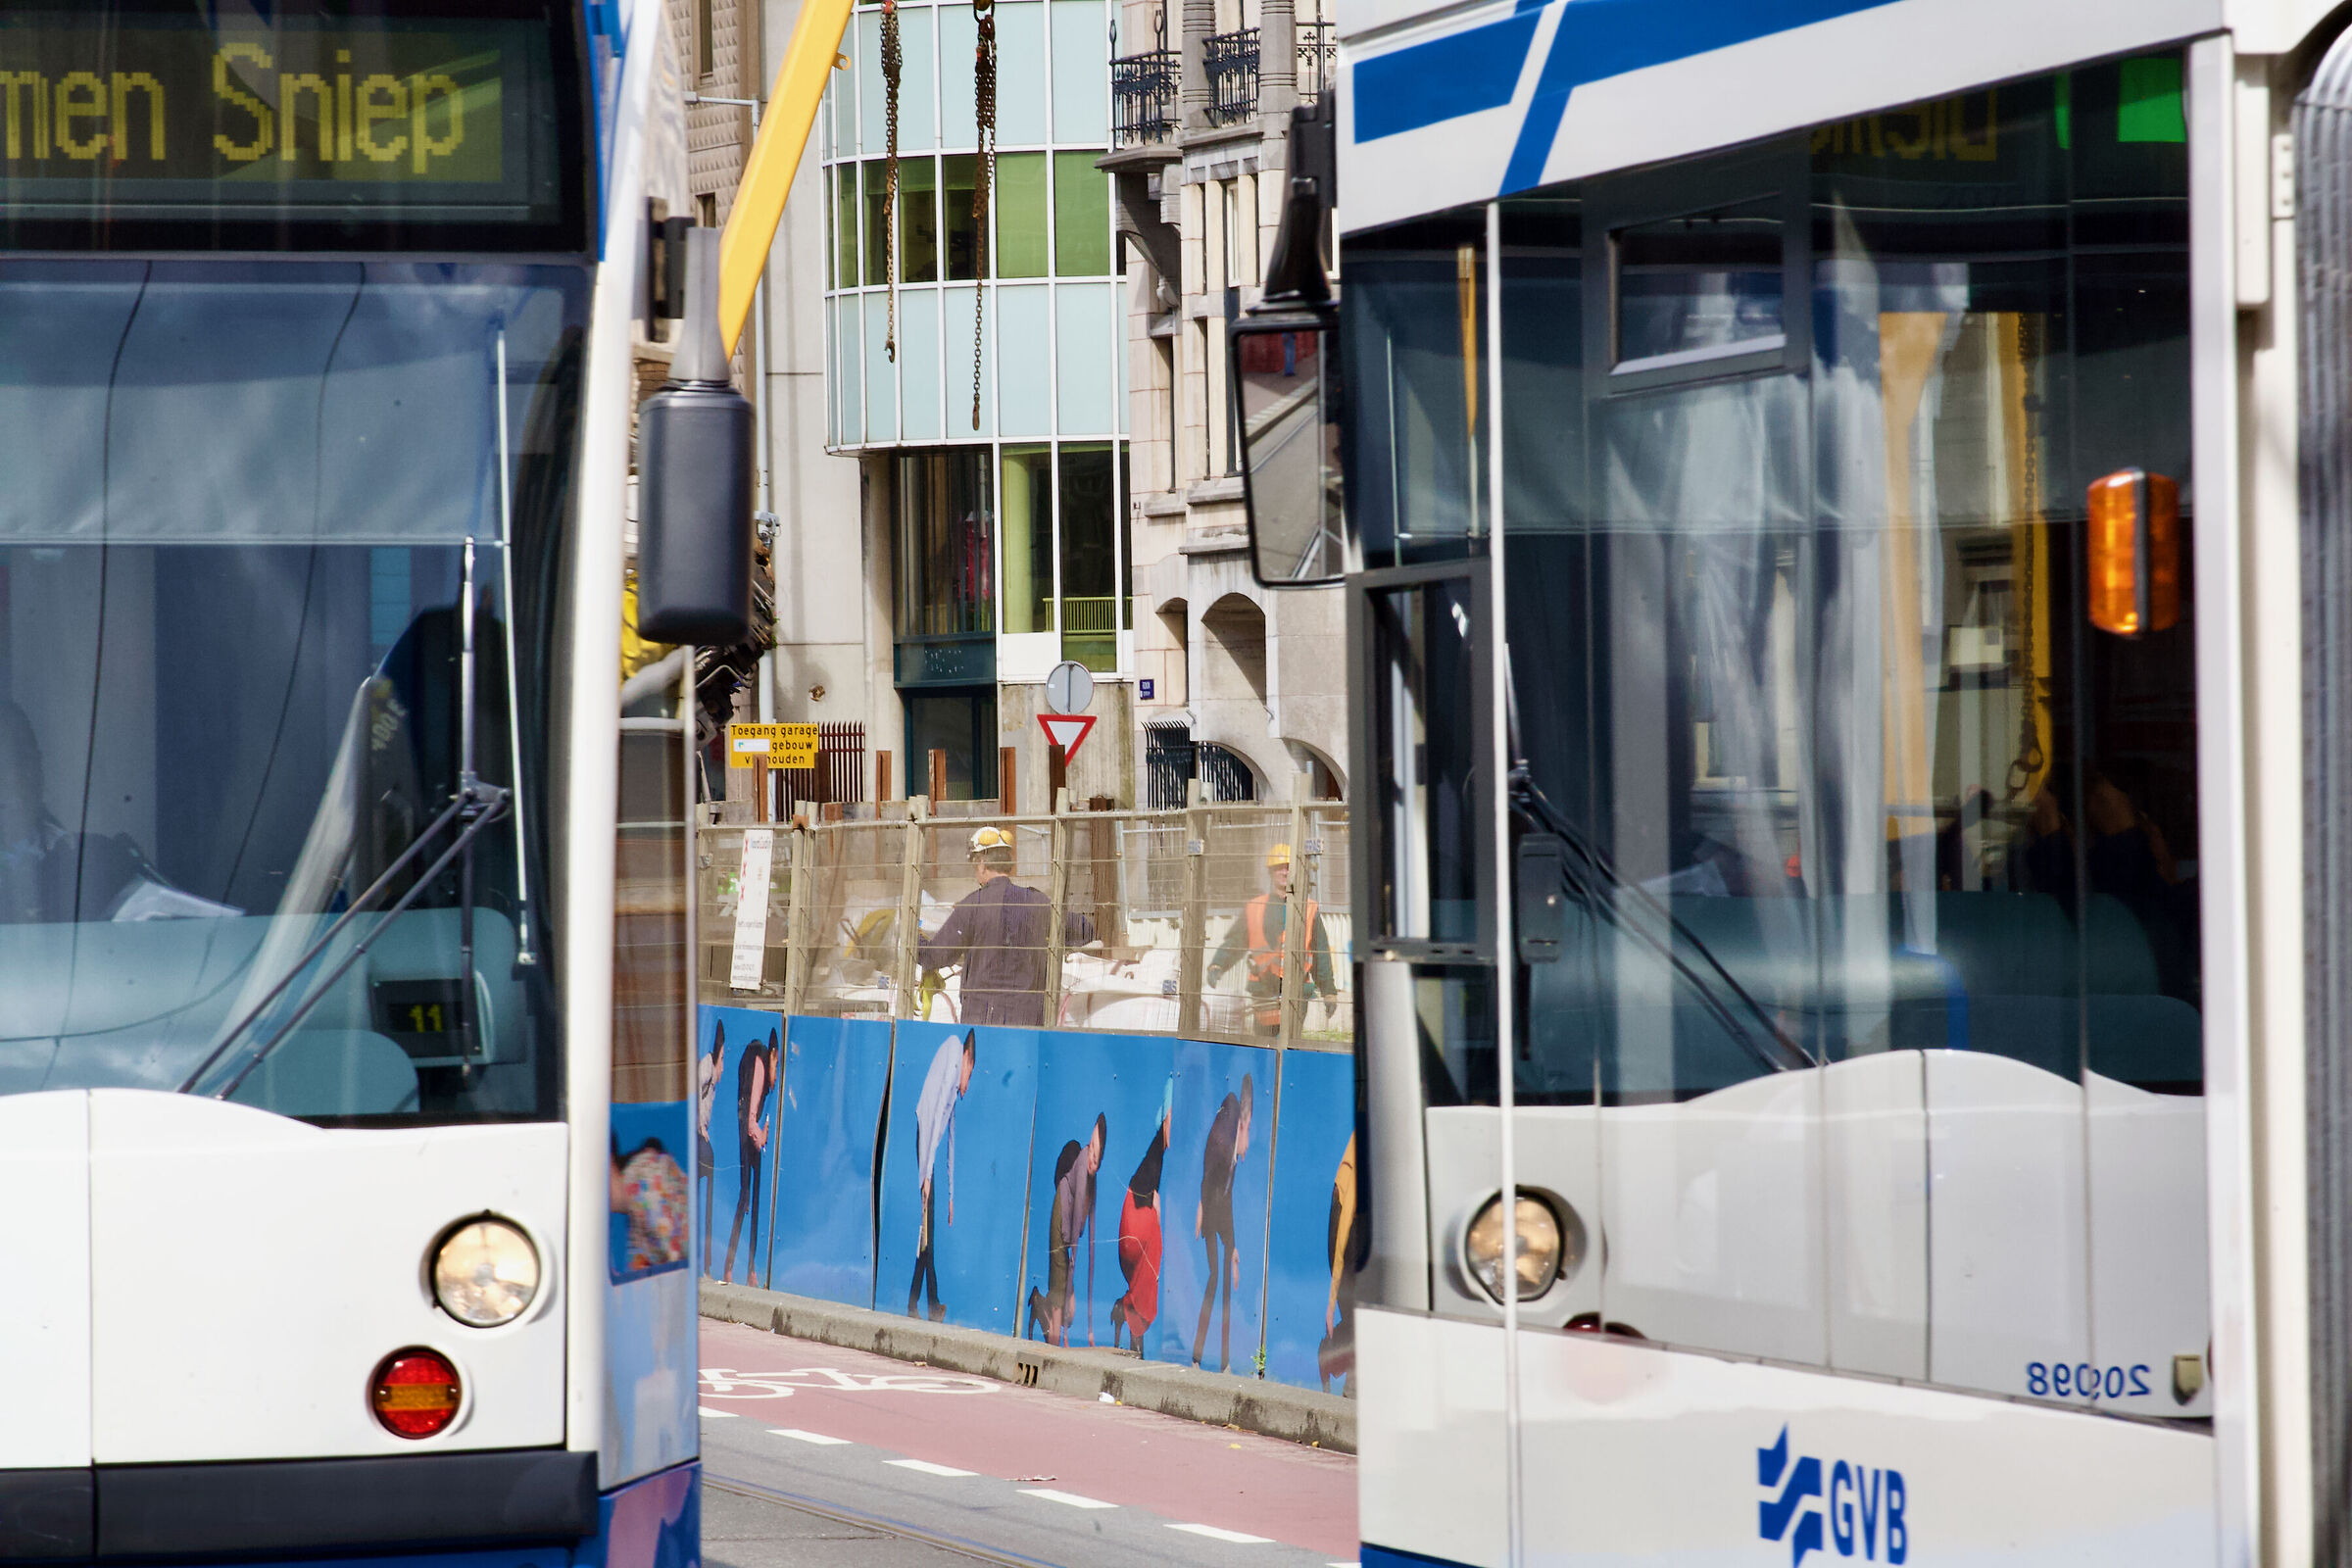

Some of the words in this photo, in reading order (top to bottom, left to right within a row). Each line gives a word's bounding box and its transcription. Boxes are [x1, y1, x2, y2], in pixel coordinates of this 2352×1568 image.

[213, 42, 465, 174] Sniep
[731, 725, 776, 738] Toegang
[780, 726, 817, 738] garage
[772, 741, 812, 753] gebouw
[745, 755, 805, 764] vouden
[409, 1004, 443, 1033] 11
[1831, 1460, 1907, 1566] GVB
